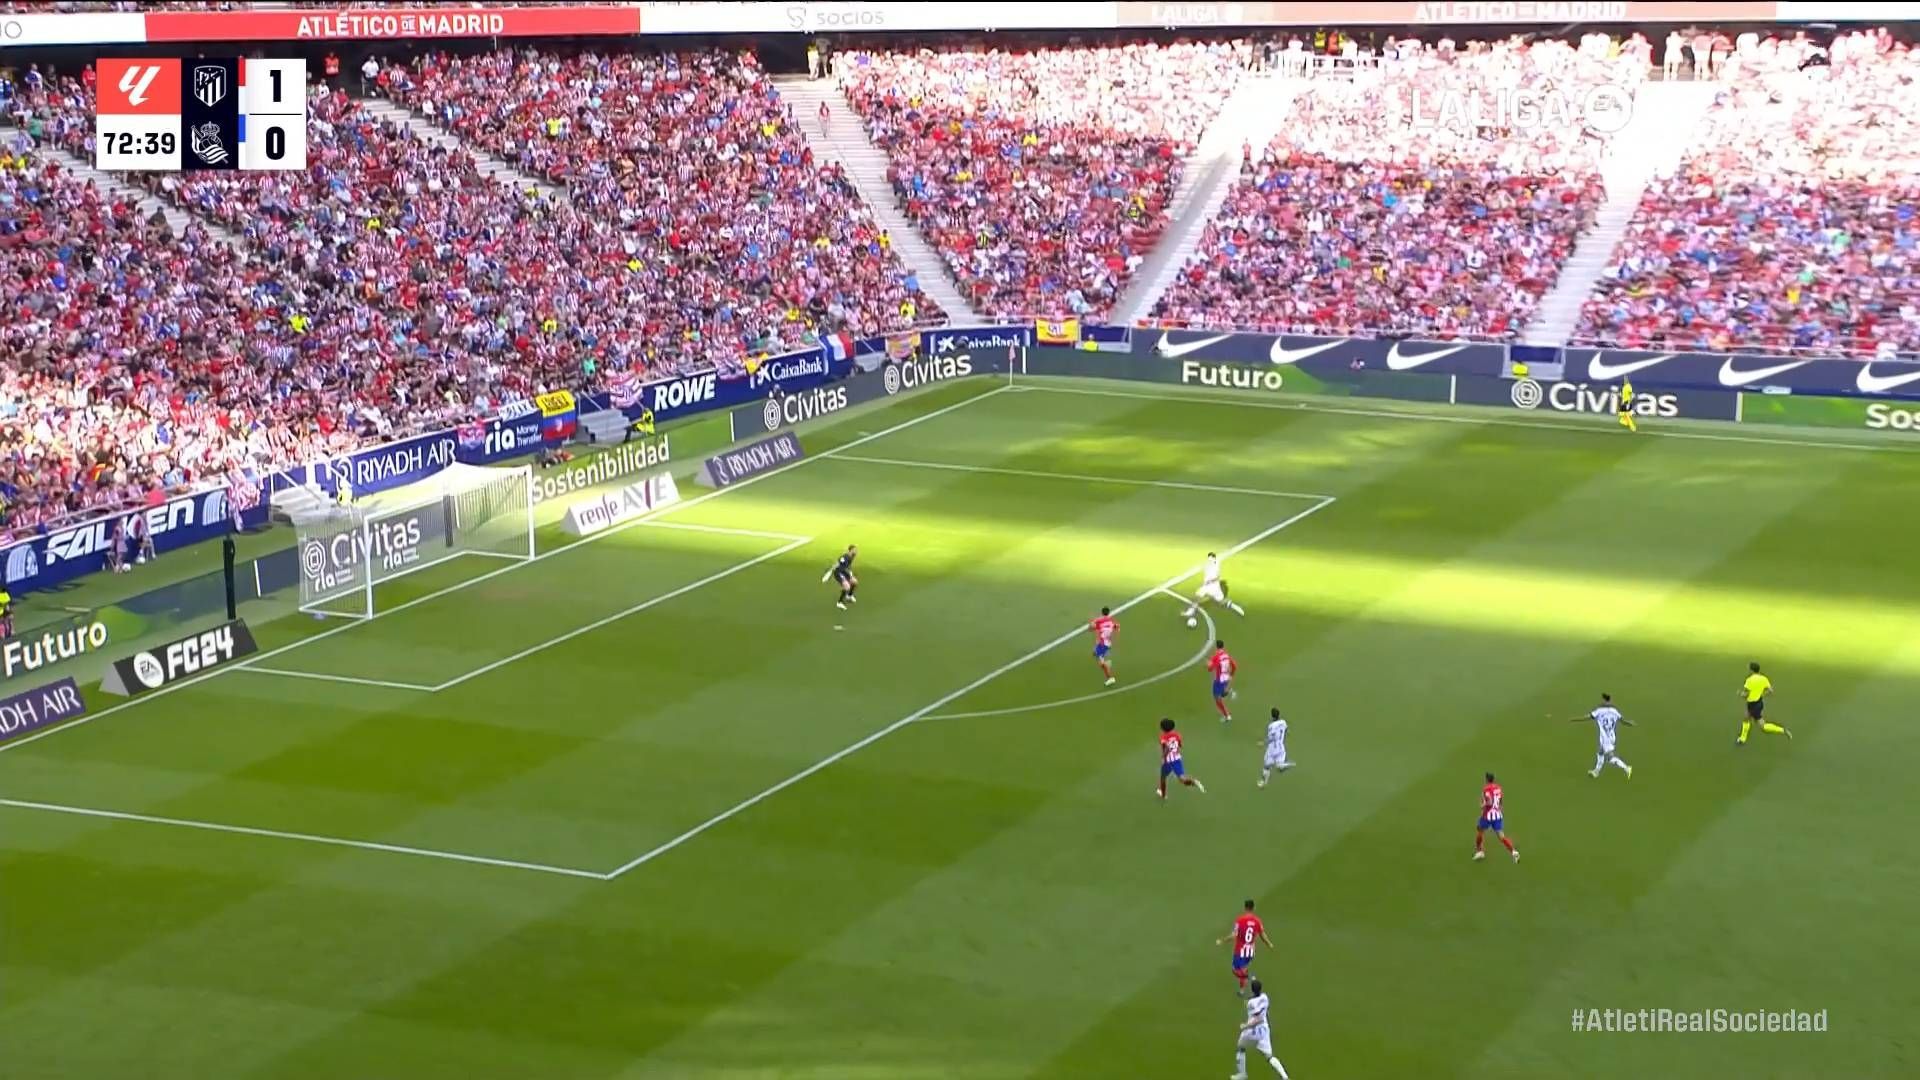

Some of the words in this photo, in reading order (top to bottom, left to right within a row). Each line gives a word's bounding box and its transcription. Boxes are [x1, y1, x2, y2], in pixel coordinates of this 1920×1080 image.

[297, 11, 397, 36] ATLÉTICO
[419, 15, 504, 35] MADRID
[771, 357, 824, 381] CaixaBank
[902, 354, 972, 389] Cívitas
[1182, 360, 1283, 390] Futuro
[654, 373, 717, 412] ROWE
[783, 385, 848, 424] Cívitas
[1549, 382, 1680, 417] Cívias
[484, 421, 515, 456] ria
[357, 446, 423, 486] RIYADH
[426, 438, 457, 468] AIR
[532, 436, 670, 501] Sostenibilidad
[726, 442, 775, 479] RIYADH
[773, 436, 797, 461] AIR
[579, 493, 618, 527] renfe
[331, 518, 421, 569] Cívitas
[3, 621, 108, 678] Futuro
[166, 625, 235, 680] FC24
[43, 685, 82, 719] AIR
[1245, 926, 1253, 943] 6
